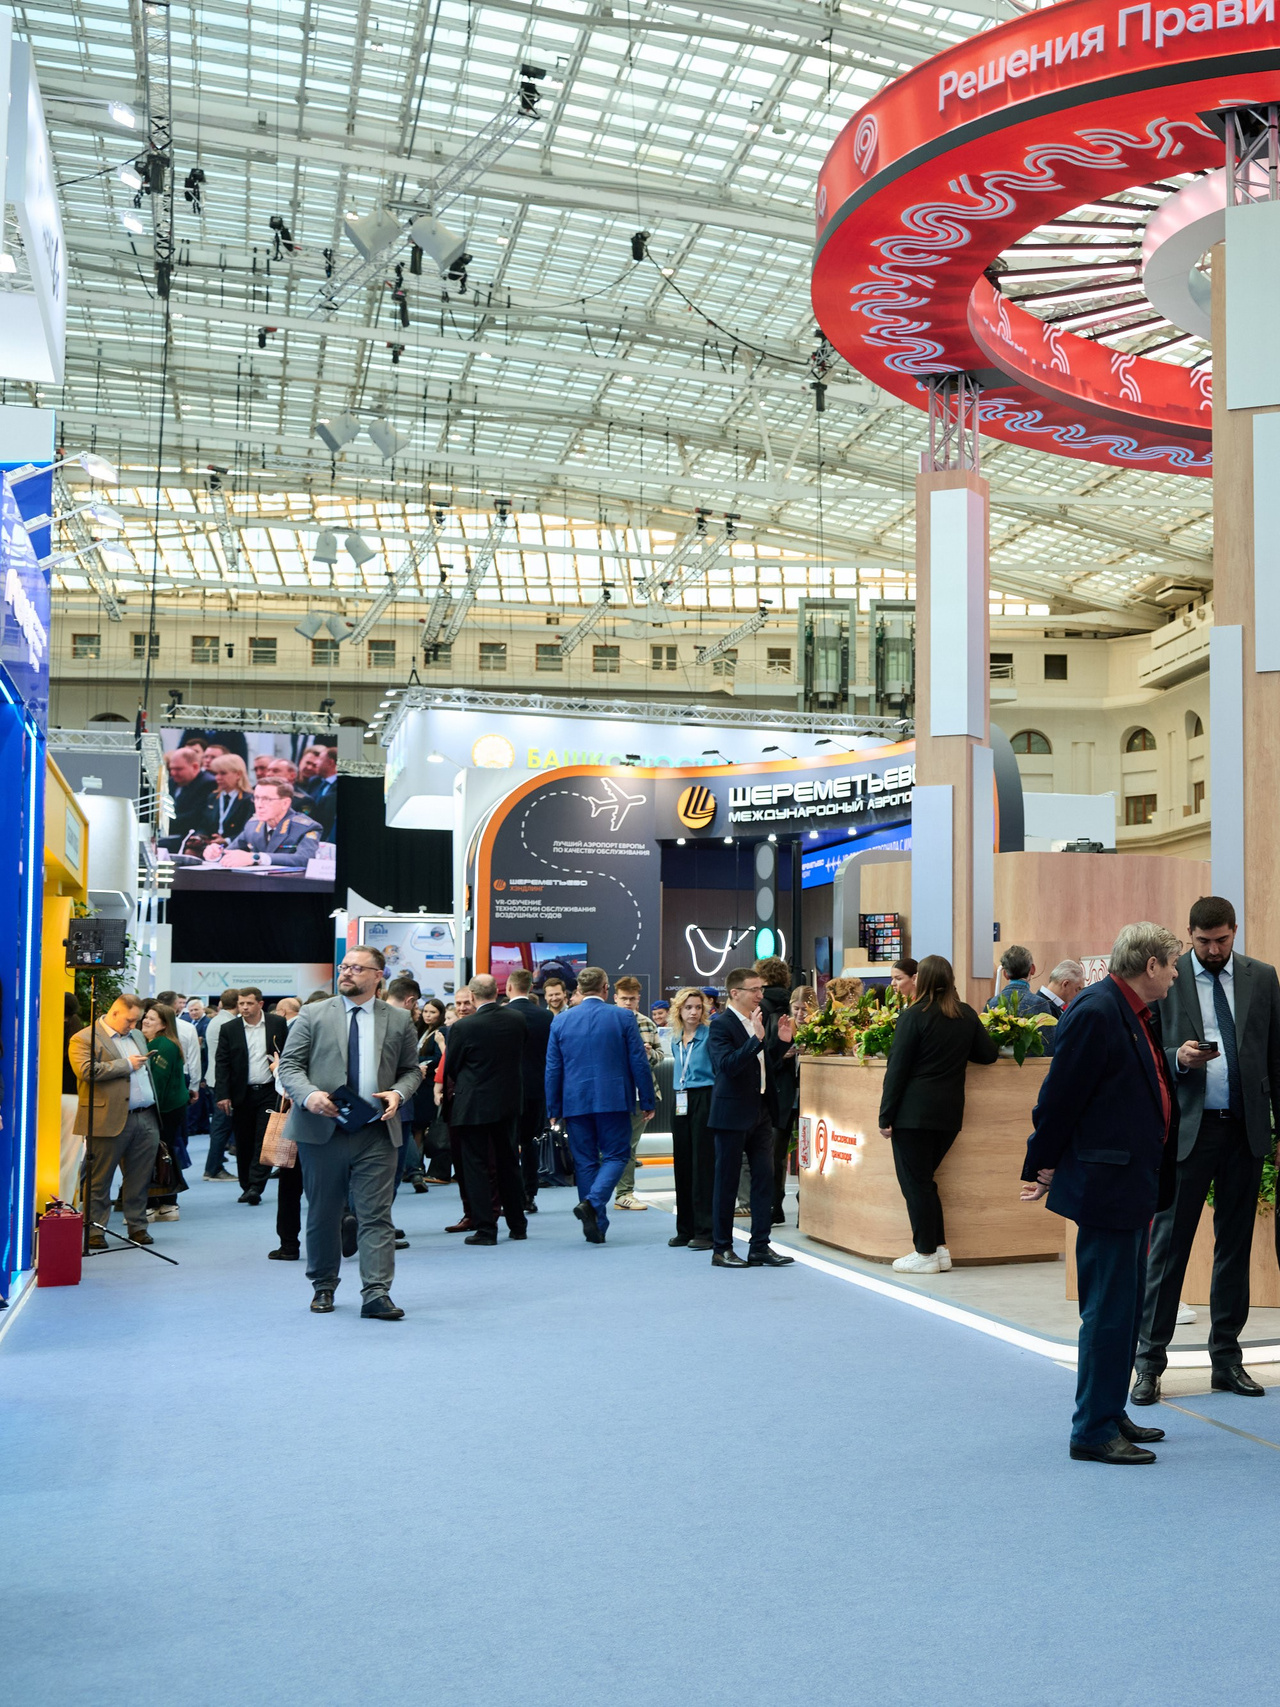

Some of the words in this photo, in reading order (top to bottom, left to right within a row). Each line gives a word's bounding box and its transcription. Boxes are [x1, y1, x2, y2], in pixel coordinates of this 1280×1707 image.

[938, 24, 1105, 112] Решения
[728, 763, 916, 807] ШЕРЕМЕТЬЕВ
[728, 797, 864, 823] МЕЖДУНАРОДНЫЙ
[553, 840, 583, 848] ЛУЧШИЙ
[583, 841, 618, 849] АЭРОПОРТ
[564, 847, 596, 855] КАЧЕСТВУ
[596, 848, 650, 856] ОБСЛУЖИВАНИЯ
